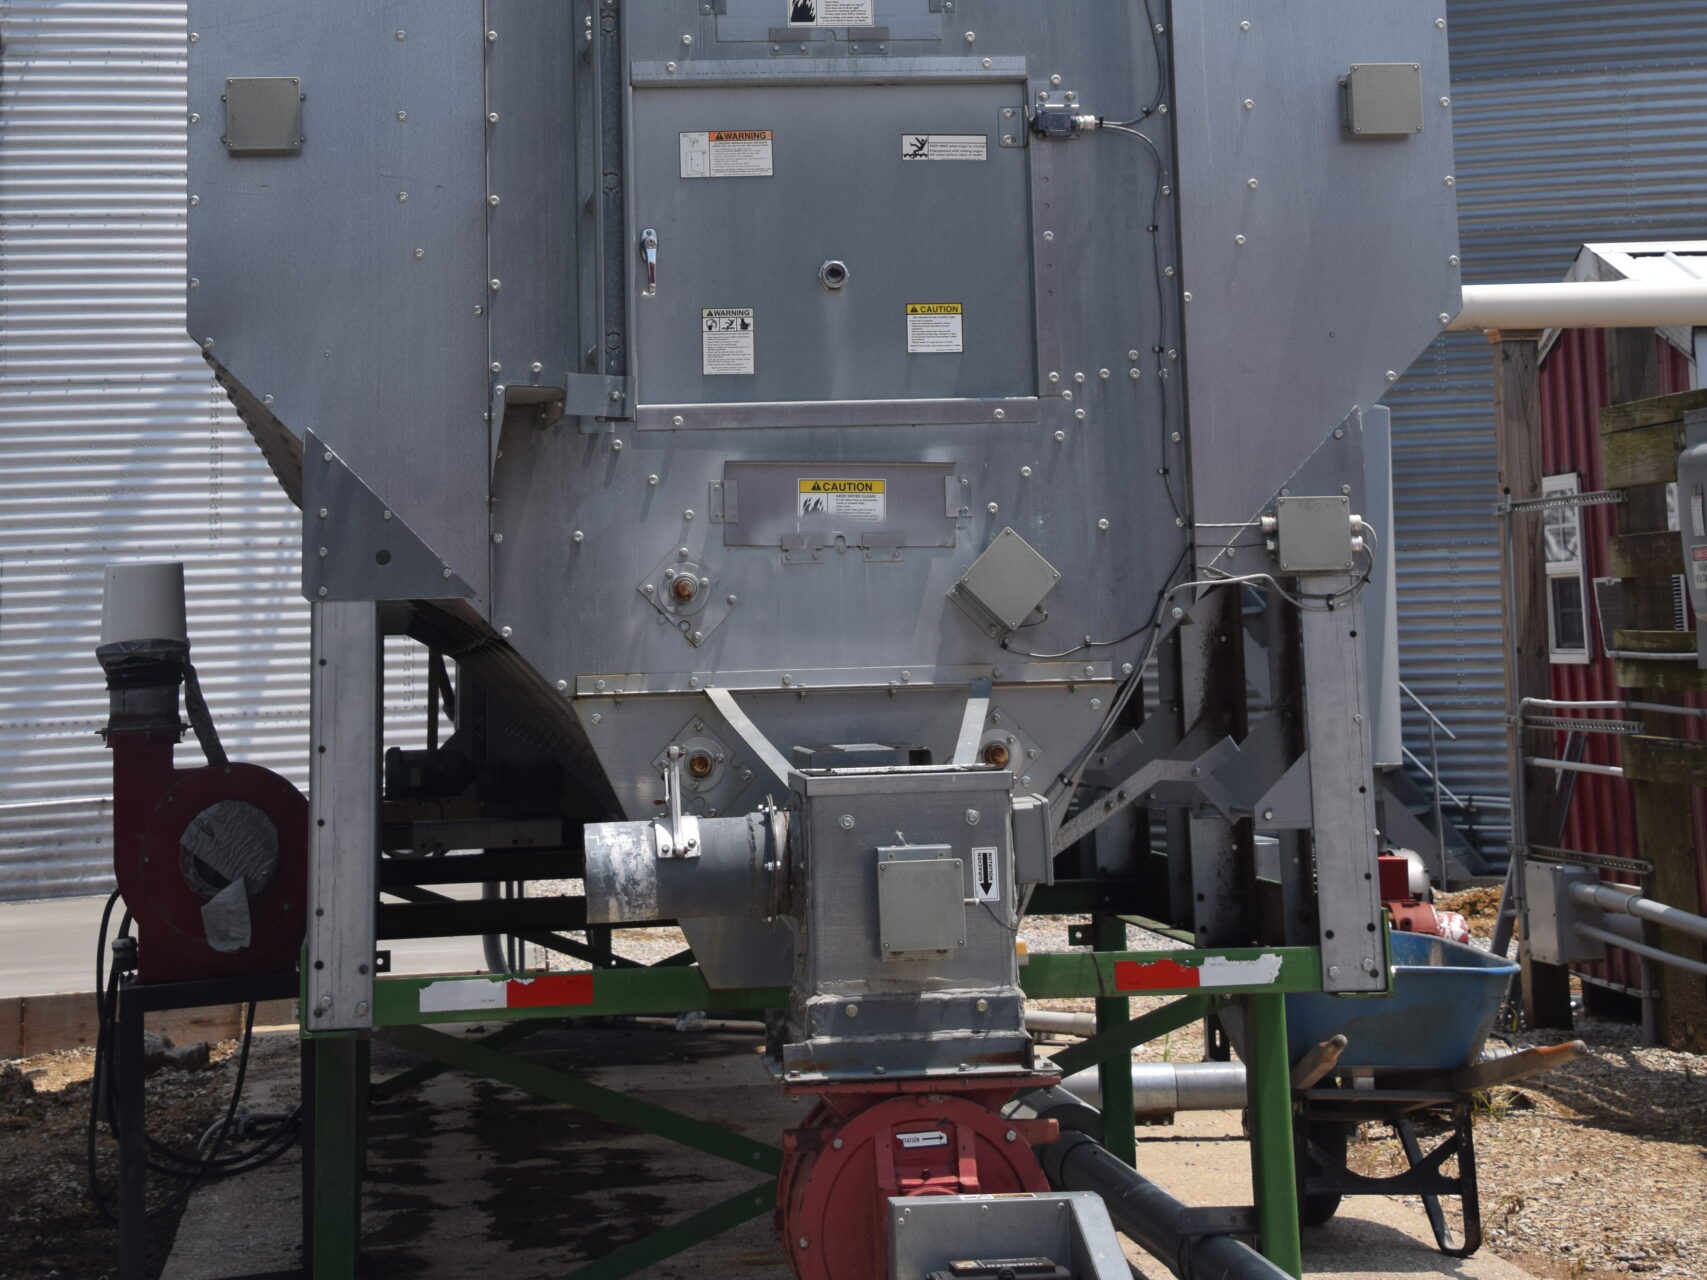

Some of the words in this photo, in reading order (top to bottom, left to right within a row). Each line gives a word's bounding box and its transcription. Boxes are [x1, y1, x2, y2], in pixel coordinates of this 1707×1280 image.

[724, 132, 766, 140] WARNING
[920, 305, 958, 313] CAUTION
[822, 482, 873, 491] CAUTION
